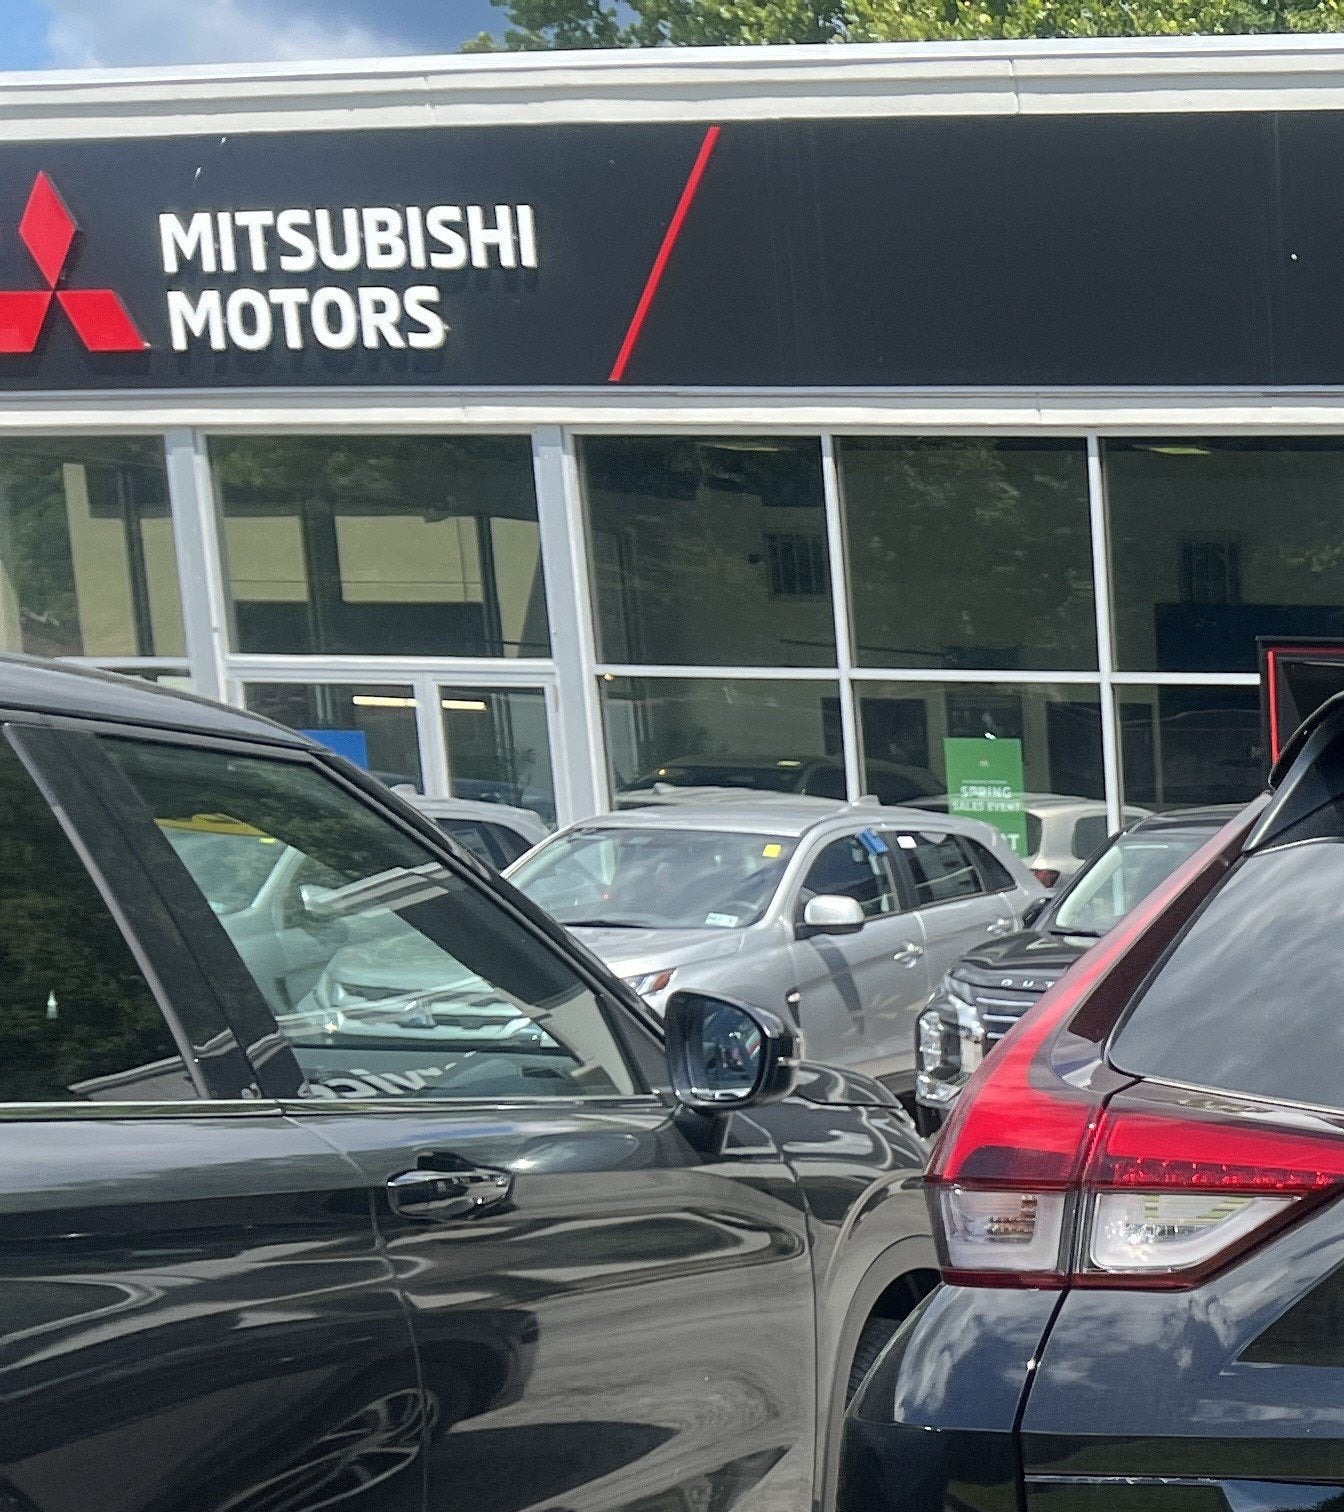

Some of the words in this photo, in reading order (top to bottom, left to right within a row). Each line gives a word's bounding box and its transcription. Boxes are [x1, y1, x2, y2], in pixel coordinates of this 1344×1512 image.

[159, 205, 538, 273] MITSUBISHI
[167, 286, 447, 351] MOTORS
[960, 786, 1011, 798] SPRING
[987, 801, 1021, 812] EVENT
